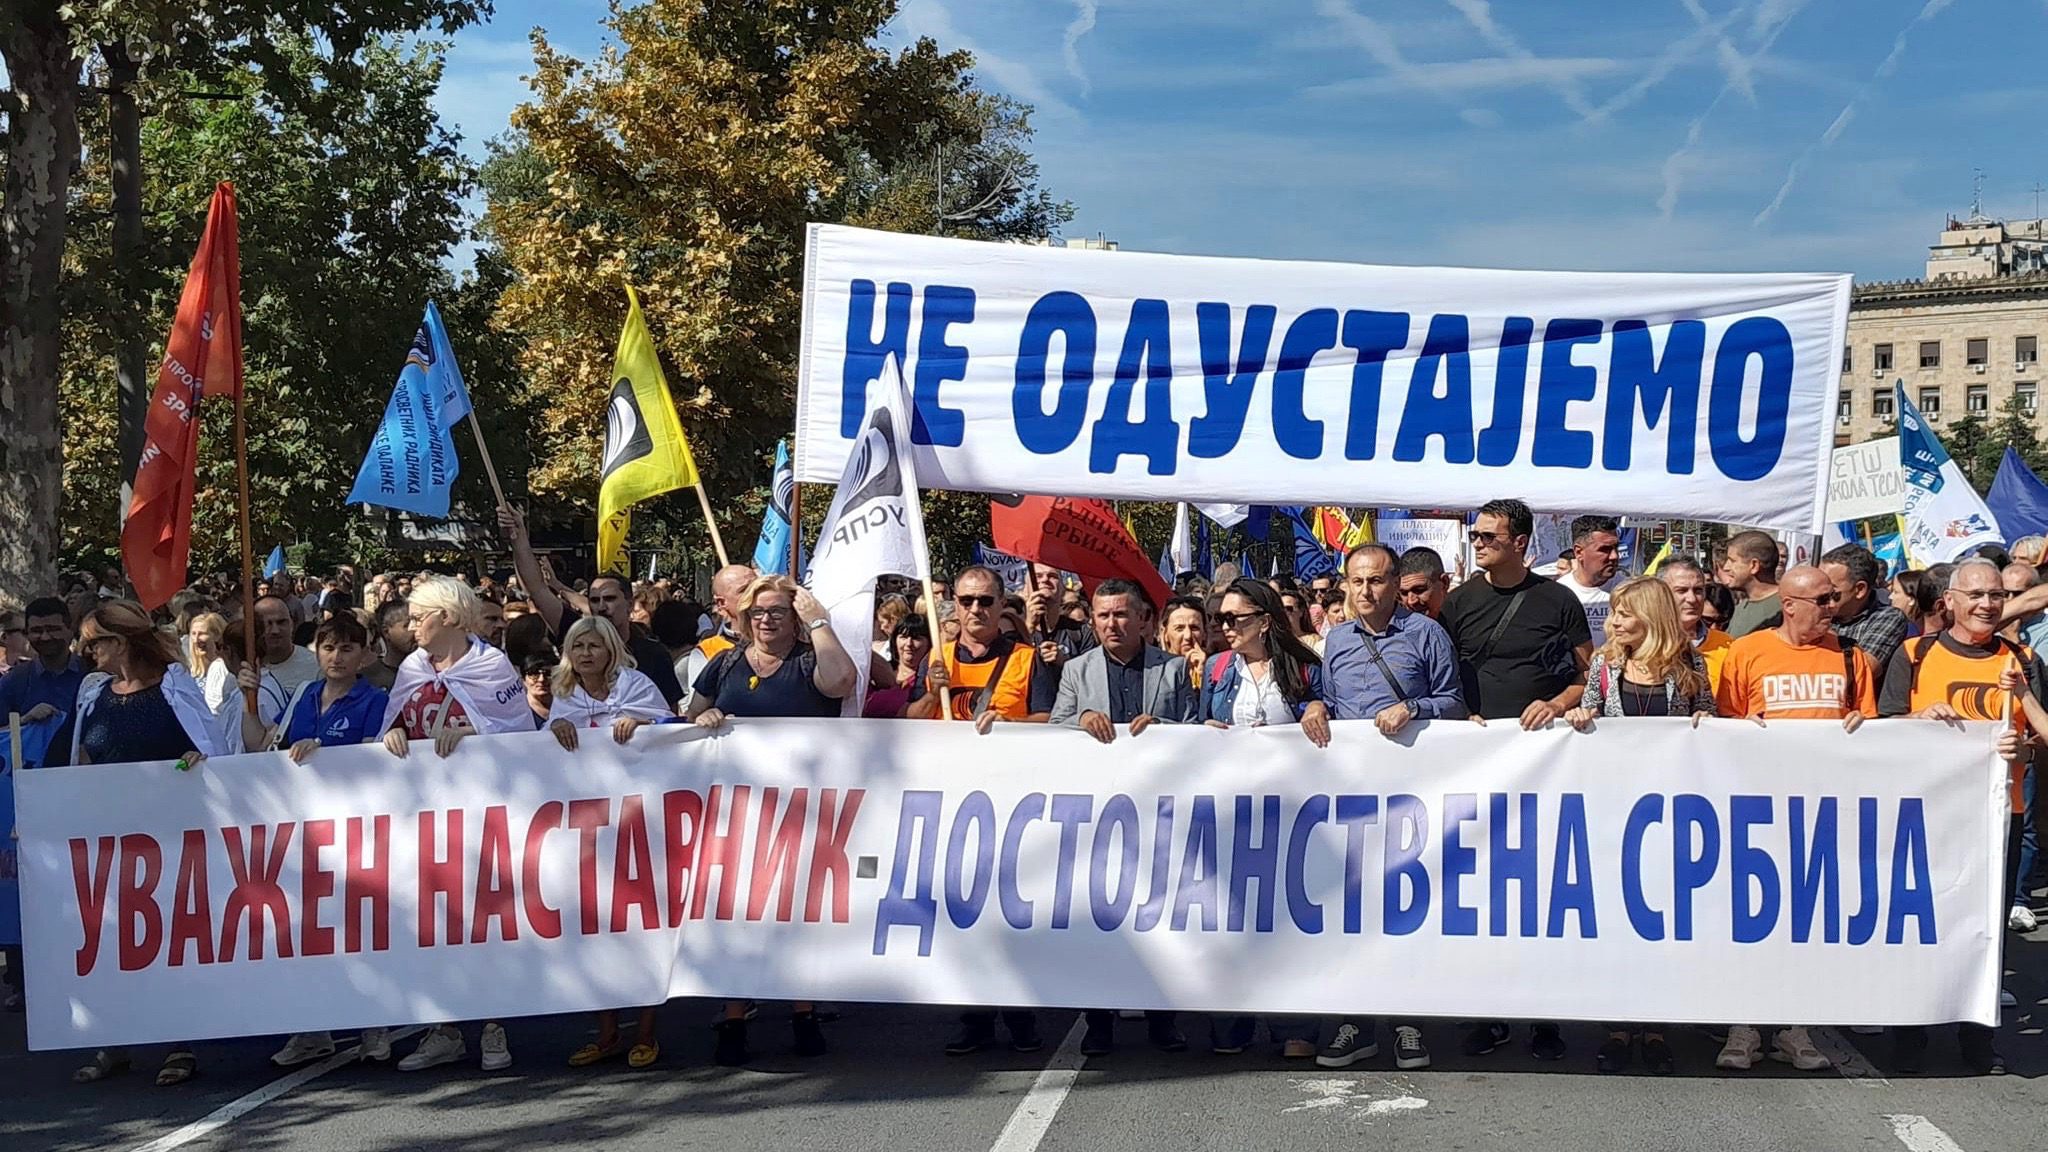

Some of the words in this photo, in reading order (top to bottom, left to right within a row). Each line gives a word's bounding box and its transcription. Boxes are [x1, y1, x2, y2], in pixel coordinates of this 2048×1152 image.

[842, 279, 976, 448] НЕ
[1013, 291, 1794, 481] ОДУСТАЈЕМО
[162, 391, 192, 424] ЗРЕ
[377, 446, 394, 494] ПАЛАНКЕ
[404, 440, 420, 494] РАДНИКА
[1042, 518, 1121, 561] СРБИЈЕ
[1763, 673, 1845, 701] DENVER
[71, 815, 390, 976] УВАЖЕН
[1622, 793, 1937, 946] СРБИЈА
